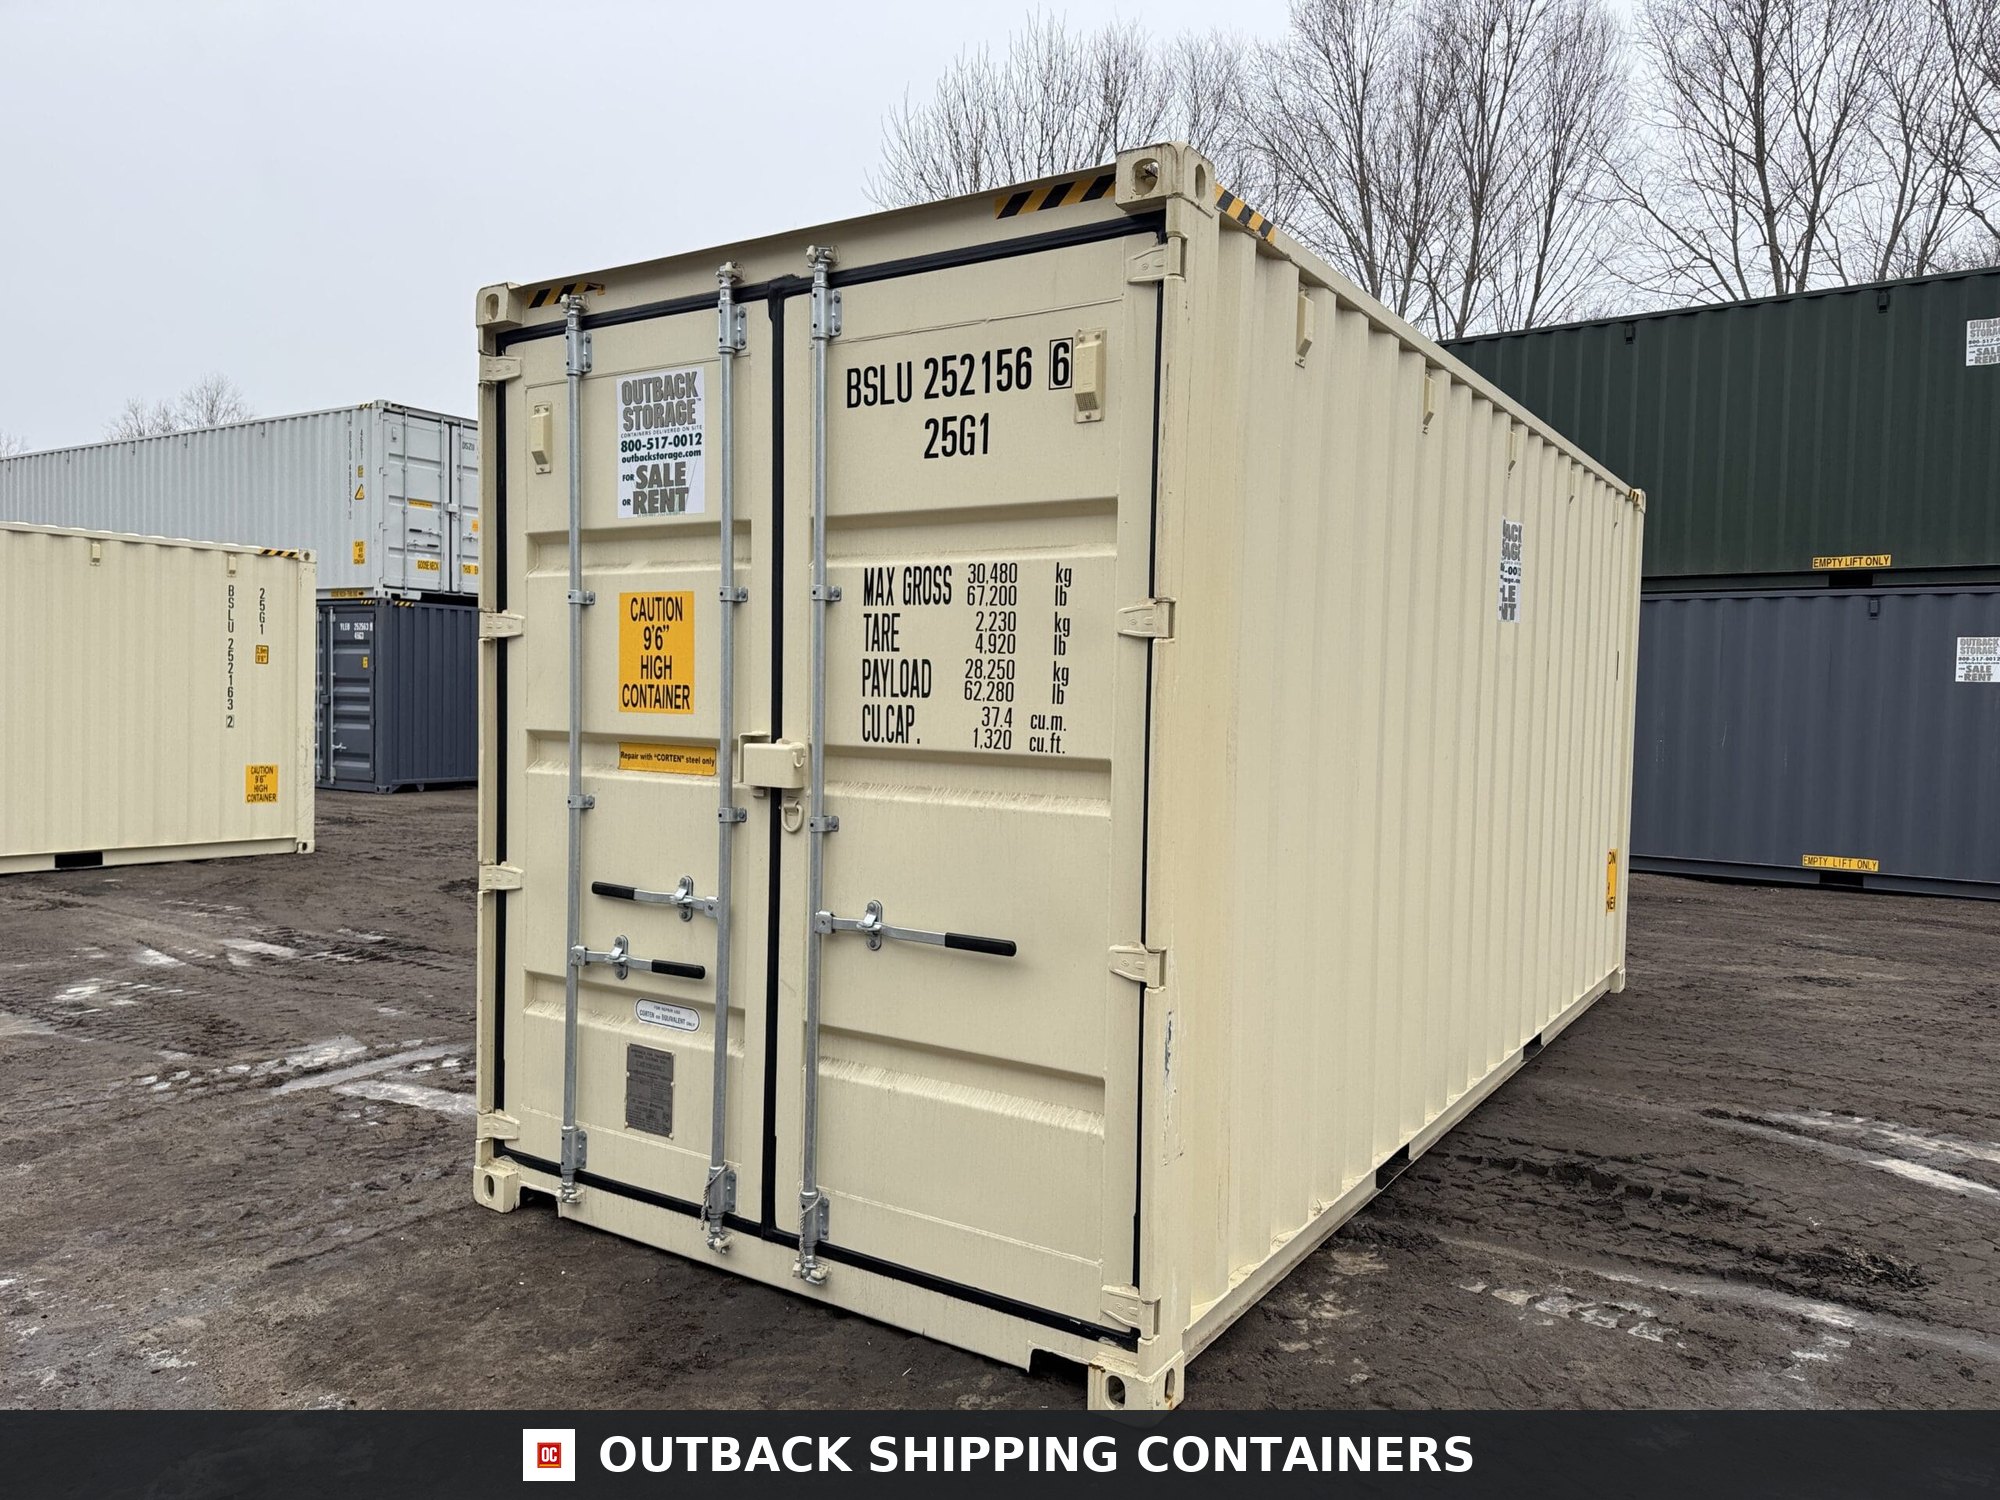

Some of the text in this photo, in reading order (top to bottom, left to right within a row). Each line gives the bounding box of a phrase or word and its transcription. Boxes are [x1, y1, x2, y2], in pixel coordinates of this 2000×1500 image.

[847, 340, 1071, 408] BSLU 252156 6
[622, 371, 699, 406] OUTBACK
[623, 398, 696, 432] STORAGE
[653, 427, 680, 435] DELIVERED
[924, 413, 989, 459] 25G1
[621, 432, 702, 453] 800-517-0012
[622, 449, 702, 464] outbackstorage.com
[636, 461, 686, 490] SALE
[633, 487, 689, 515] RENT
[1813, 556, 1889, 568] EMPTY LIFT ONLY
[864, 562, 1072, 606] MAX GROSS 30,480 kg
[967, 585, 1067, 607] 67,200 lb
[227, 585, 235, 633] BSLU
[630, 597, 683, 622] CAUTION
[863, 611, 1070, 652] TARE 2,230 kg
[1960, 638, 1999, 646] OUTBACK
[975, 633, 1066, 655] 4,920 lb
[1960, 646, 1997, 654] STORAGE
[640, 655, 672, 680] HIGH
[862, 658, 1069, 698] PAYLOAD 28,250 kg
[1964, 673, 1993, 681] RENT
[1966, 665, 1992, 673] SALE
[622, 683, 690, 710] CONTAINER
[964, 681, 1064, 704] 62,280 lb
[227, 715, 234, 728] 2
[981, 706, 1012, 728] 37.4
[1030, 713, 1066, 731] cu.m.
[973, 727, 1065, 753] 1,320 cu.ft.
[251, 766, 273, 774] CAUTION
[620, 751, 639, 760] Repair
[685, 757, 701, 765] steel
[702, 758, 715, 767] only
[247, 793, 277, 802] CONTAINER
[254, 784, 268, 792] HIGH
[1804, 856, 1877, 870] EMPTY LIFT ONLY
